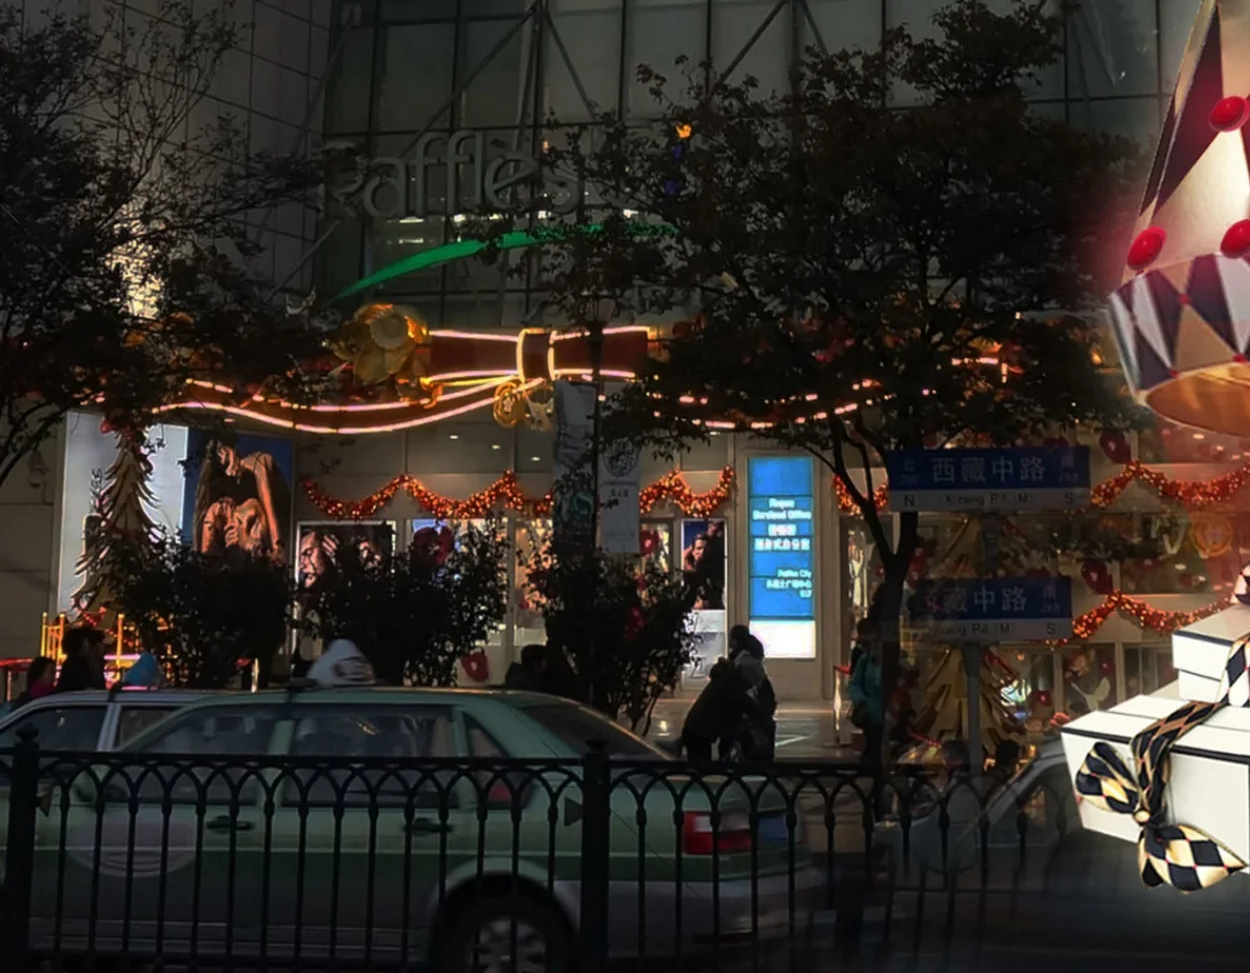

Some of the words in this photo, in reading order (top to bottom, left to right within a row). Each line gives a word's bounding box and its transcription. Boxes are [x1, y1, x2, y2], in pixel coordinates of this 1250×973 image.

[930, 456, 1046, 484] 西藏中路
[904, 494, 915, 507] N
[1064, 492, 1074, 505] S
[1046, 622, 1056, 635] S
